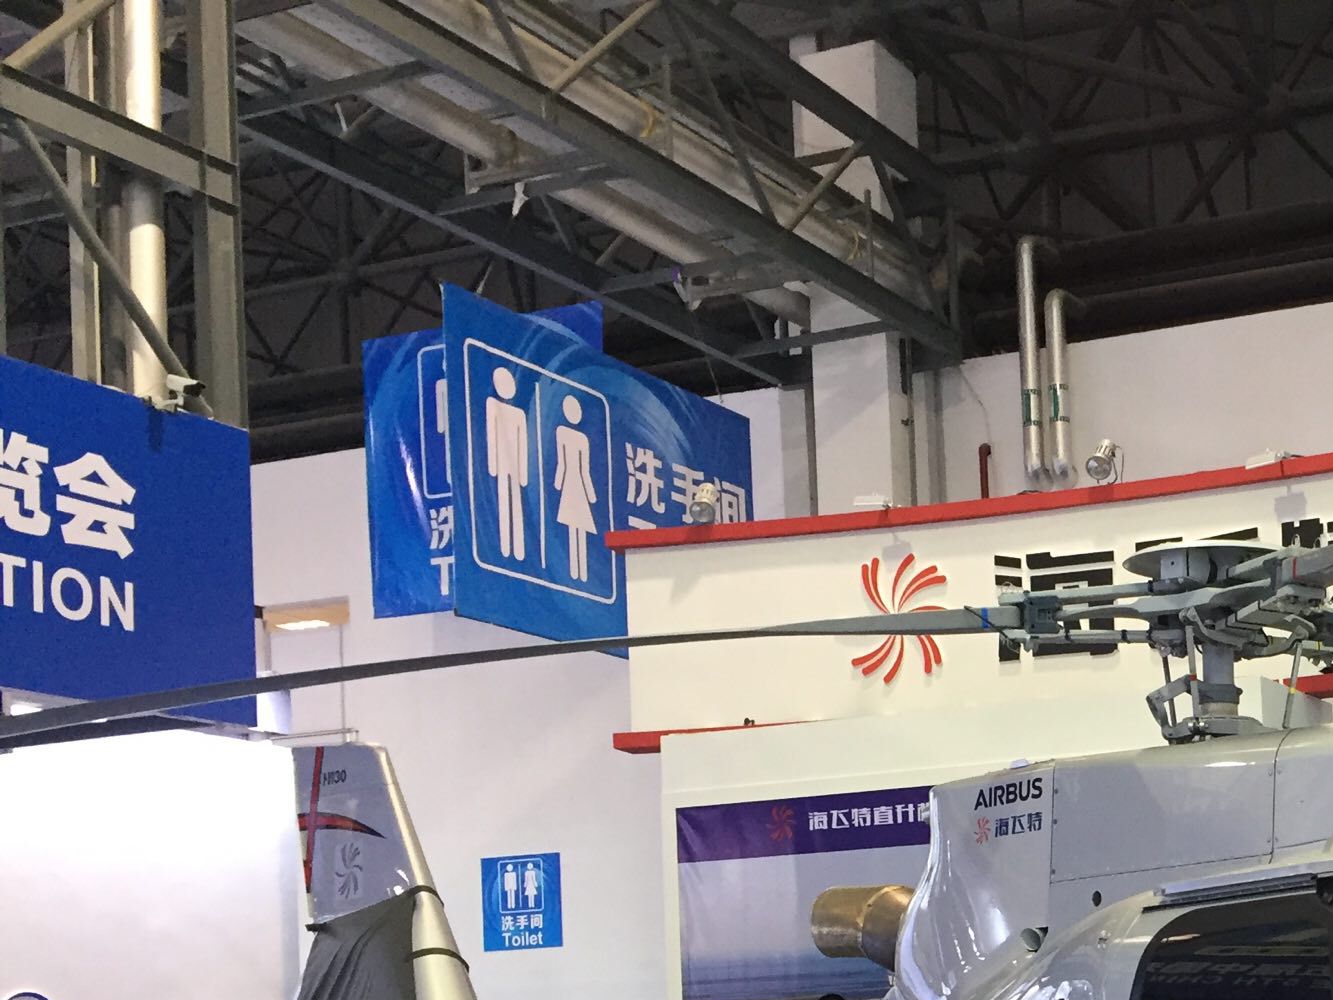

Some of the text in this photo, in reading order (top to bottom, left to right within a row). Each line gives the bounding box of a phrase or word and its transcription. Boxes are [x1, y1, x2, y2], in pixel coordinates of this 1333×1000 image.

[0, 553, 134, 632] TION
[974, 777, 1043, 811] AIRBUS
[994, 812, 1042, 838] 海飞特
[501, 914, 543, 931] 洗手间
[501, 931, 543, 947] Toilet
